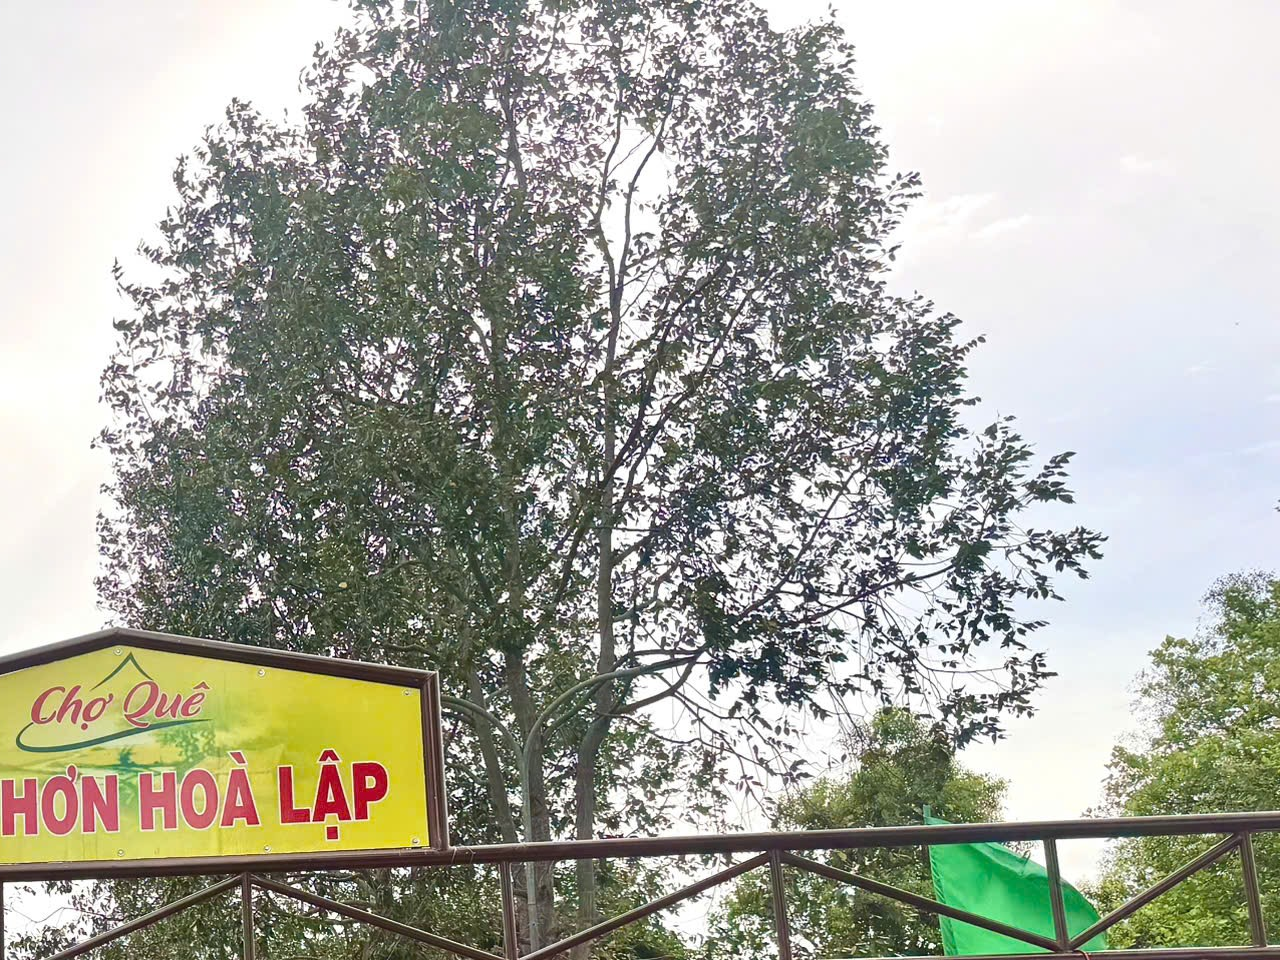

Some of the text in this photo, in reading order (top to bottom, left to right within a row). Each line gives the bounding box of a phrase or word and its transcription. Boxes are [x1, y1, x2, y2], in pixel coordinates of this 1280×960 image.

[31, 680, 210, 731] Chợ Quê
[138, 751, 261, 832] HOÀ
[277, 749, 388, 840] LẬP
